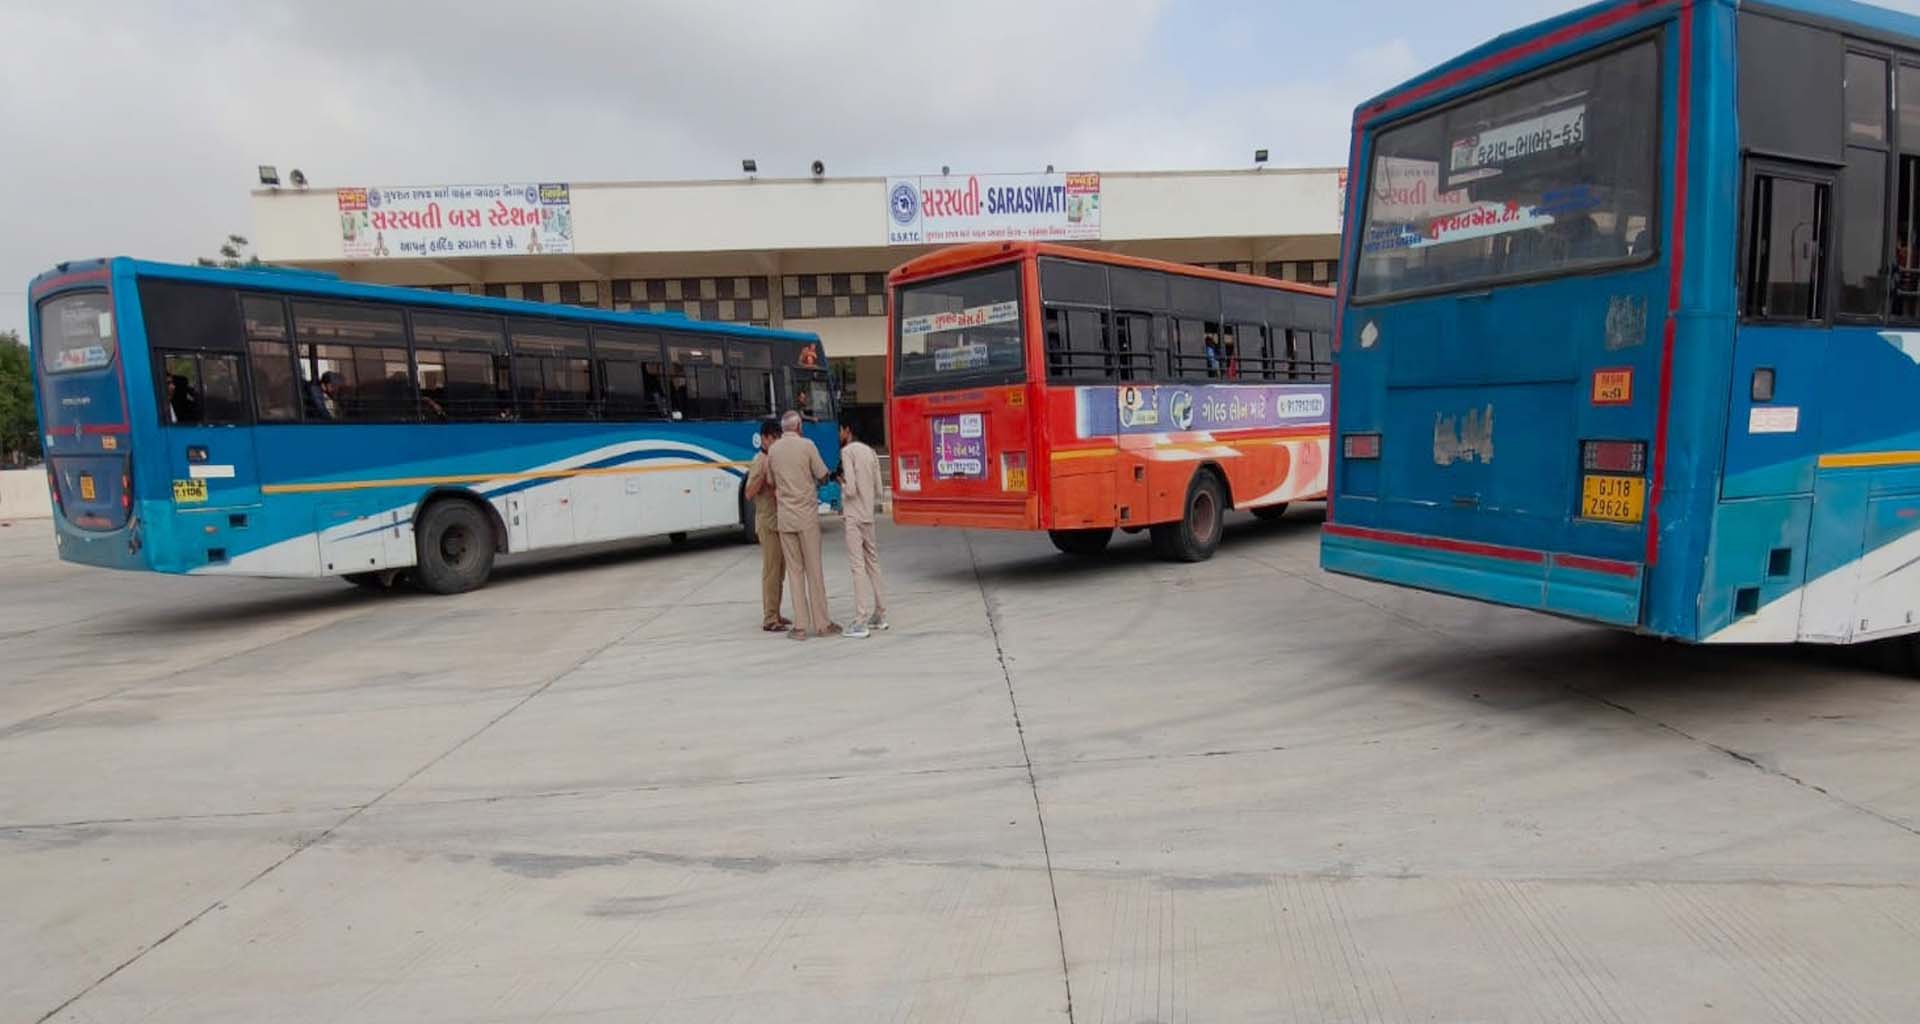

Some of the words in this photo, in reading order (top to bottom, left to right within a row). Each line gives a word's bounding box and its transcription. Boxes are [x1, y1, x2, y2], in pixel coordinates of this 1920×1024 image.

[371, 202, 443, 230] સરસ્વતી
[448, 207, 482, 228] બસ
[488, 200, 540, 227] સ્ટેશન
[987, 186, 1066, 215] SARASWATI
[1599, 478, 1631, 497] GJ18
